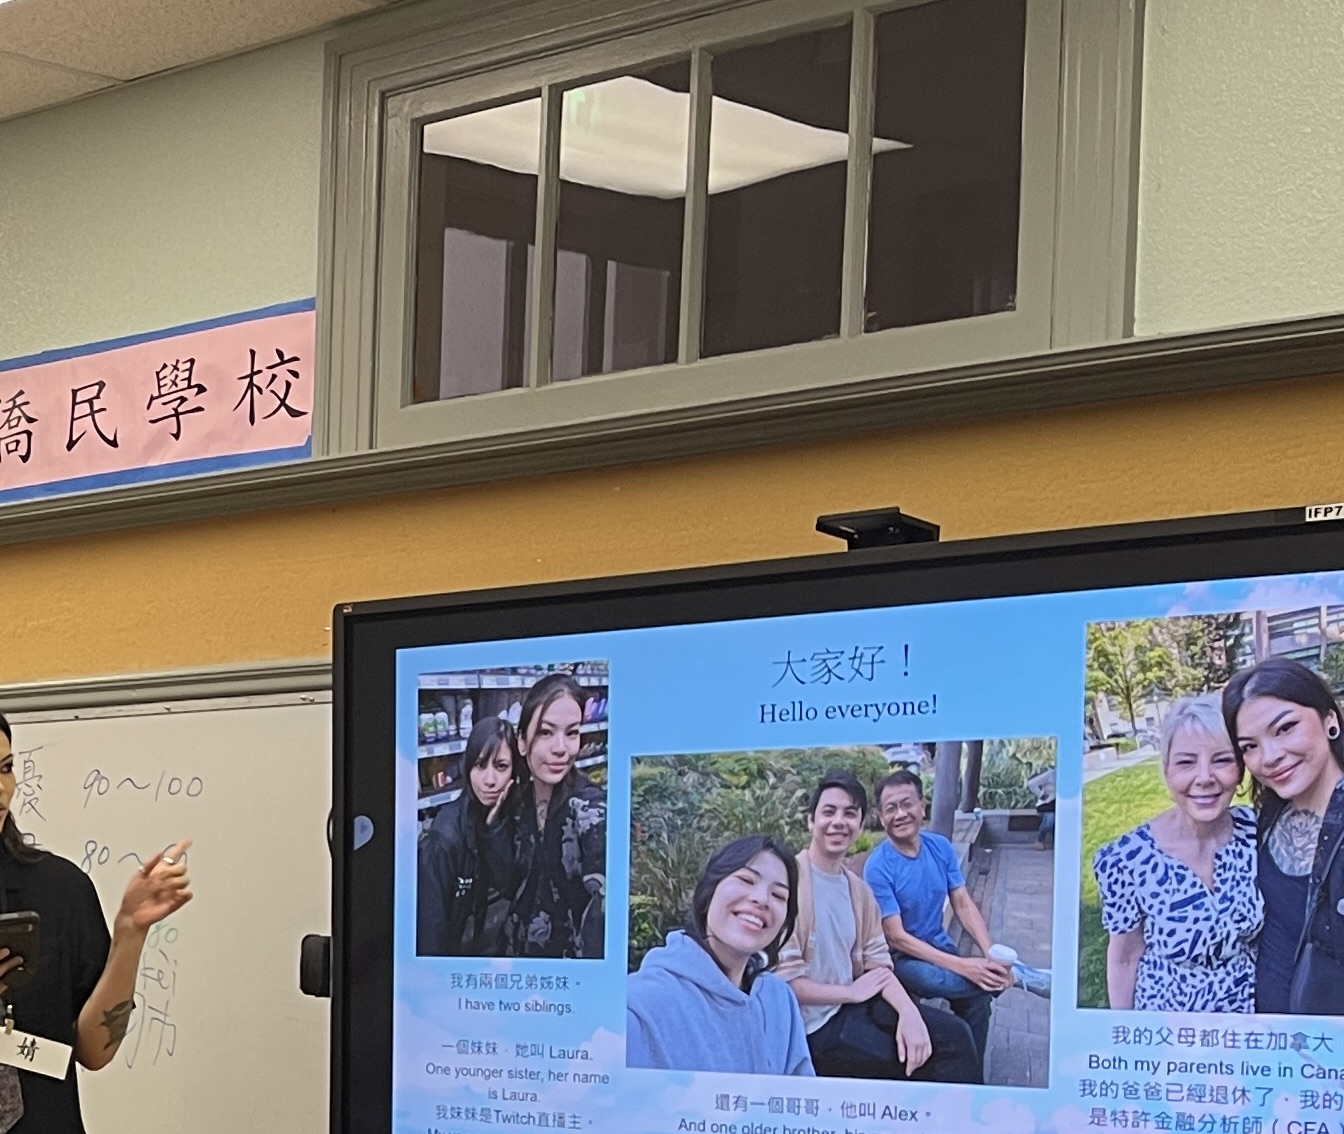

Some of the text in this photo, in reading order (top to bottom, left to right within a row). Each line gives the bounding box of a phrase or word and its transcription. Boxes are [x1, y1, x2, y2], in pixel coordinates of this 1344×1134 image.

[771, 643, 910, 687] 大家好！
[759, 694, 938, 724] Hello everyone!
[464, 999, 495, 1011] have
[498, 1000, 521, 1012] two
[524, 1000, 576, 1015] siblings.
[549, 1045, 594, 1061] Laura.
[425, 1062, 610, 1085] One younger sister, her name
[1088, 1054, 1128, 1071] Both
[1134, 1058, 1161, 1075] my
[1166, 1059, 1234, 1076] parents
[1240, 1060, 1272, 1077] live
[1277, 1062, 1294, 1078] in
[487, 1087, 498, 1100] is
[678, 1118, 706, 1133] And
